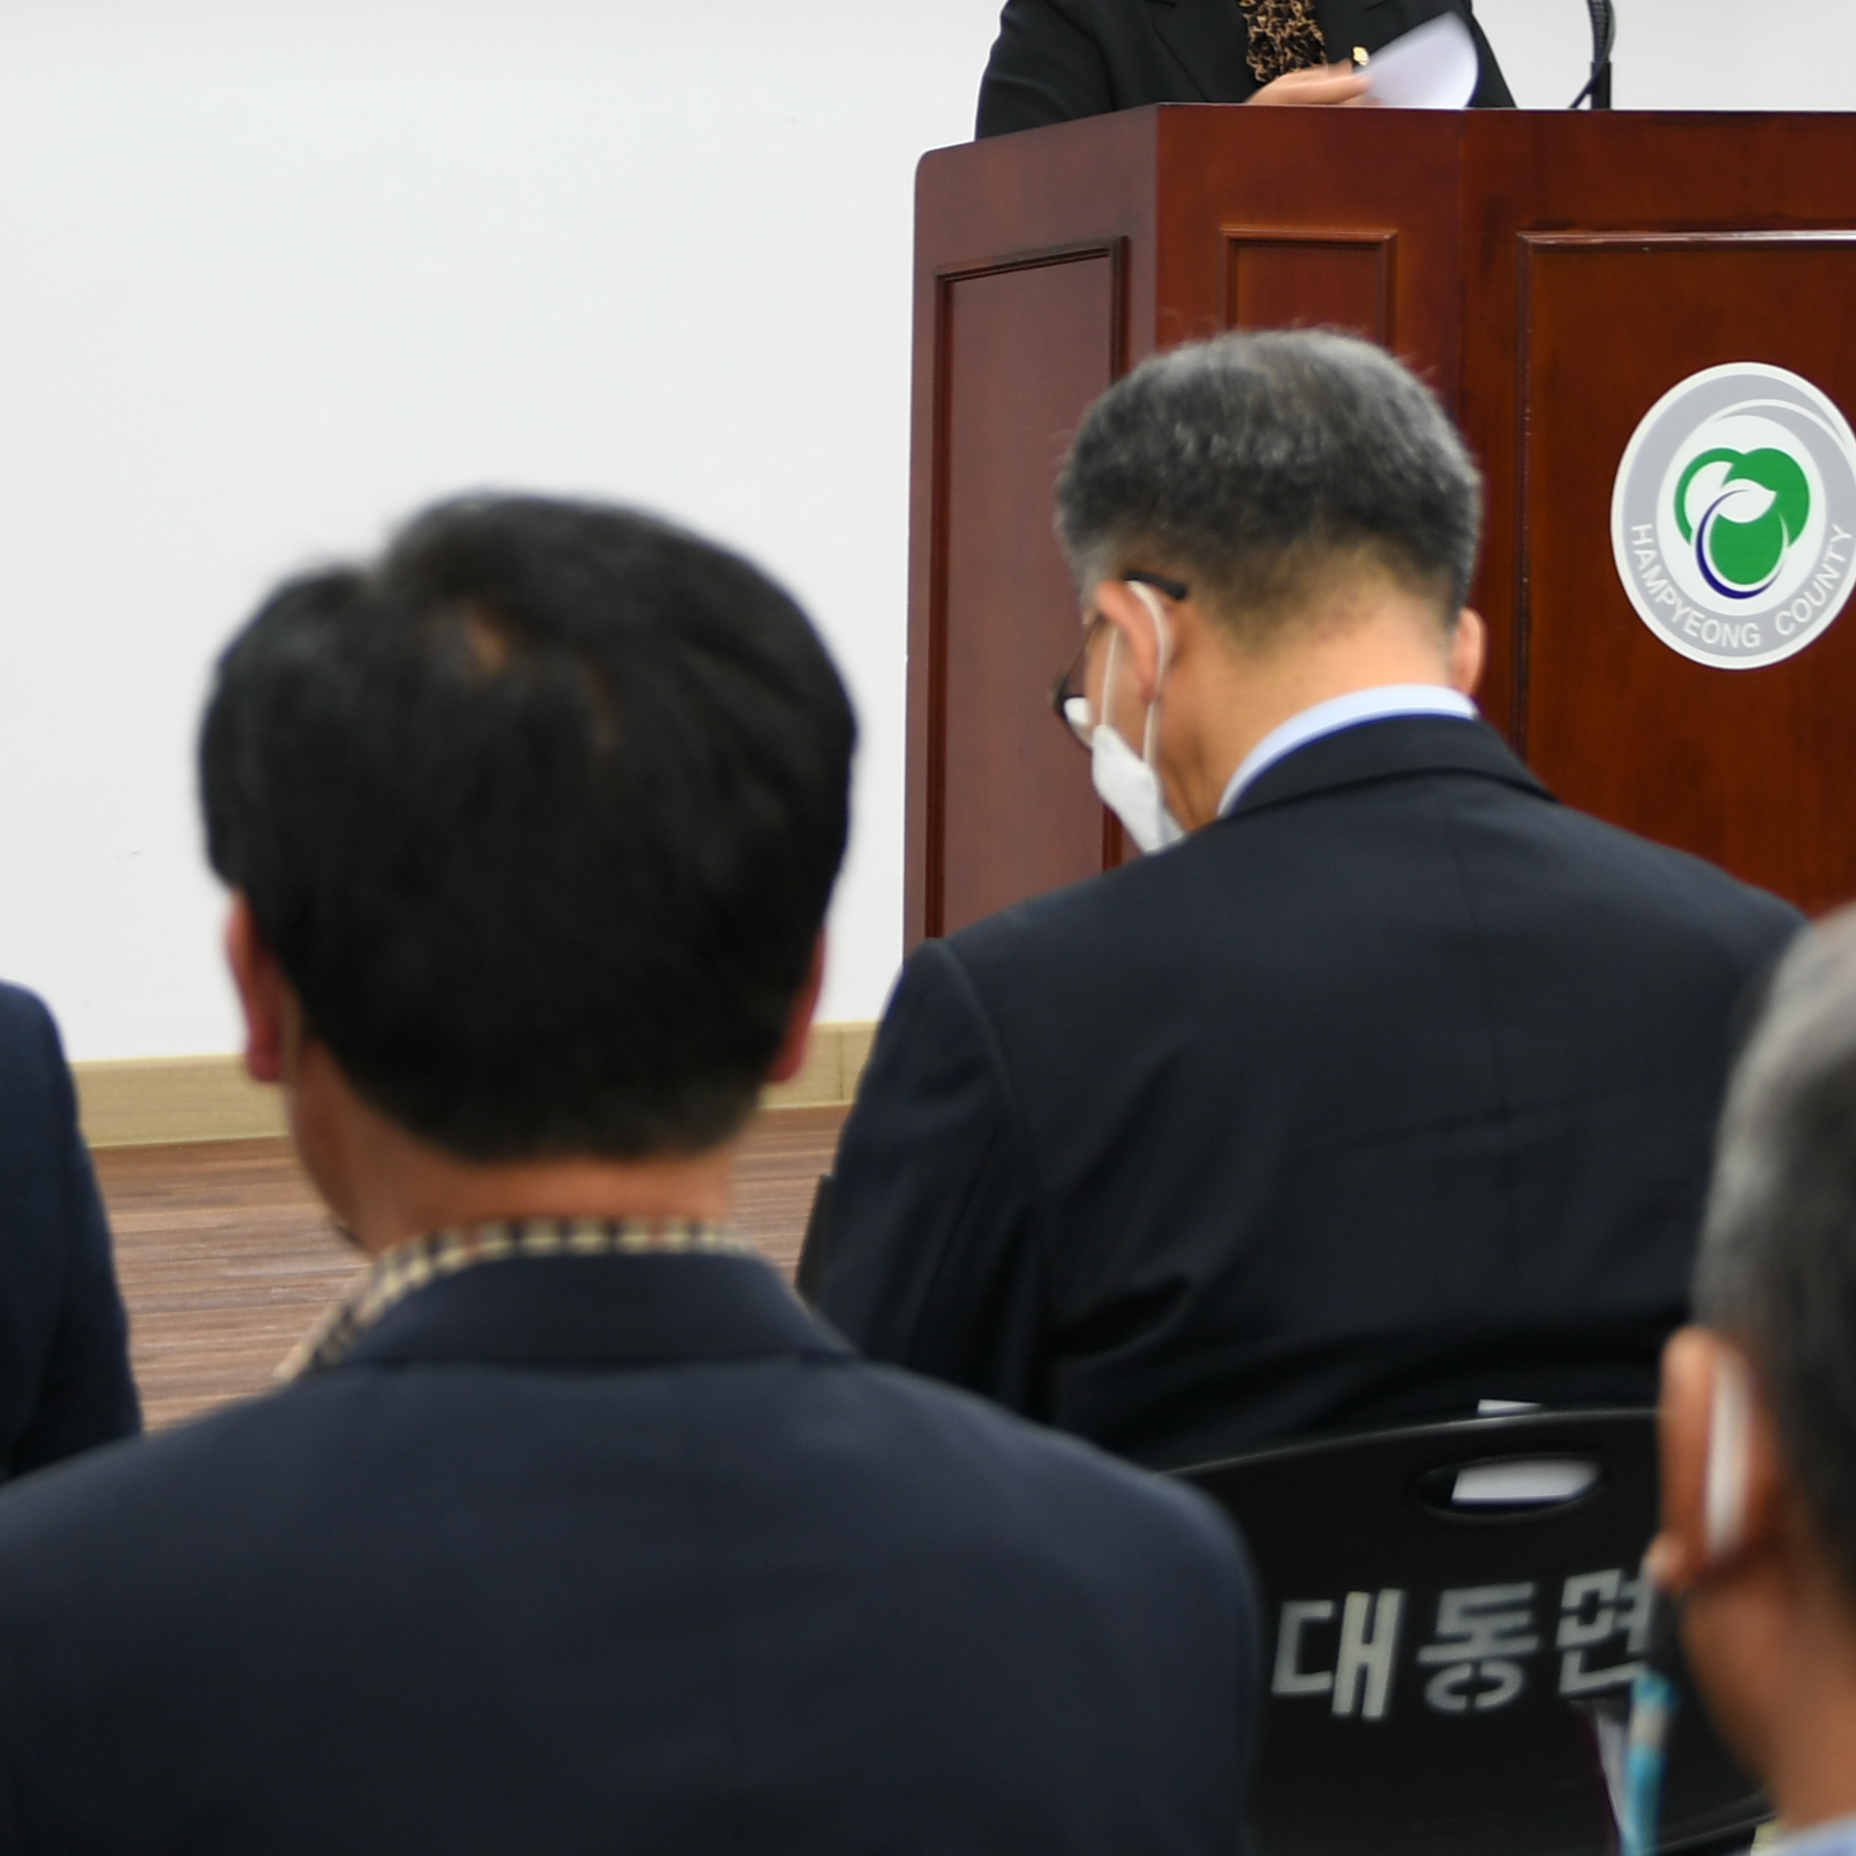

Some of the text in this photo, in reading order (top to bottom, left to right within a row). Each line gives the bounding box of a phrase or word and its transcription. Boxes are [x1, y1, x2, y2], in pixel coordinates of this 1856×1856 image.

[1630, 523, 1853, 649] HAMPYEONG COUNTY
[1270, 1568, 1654, 1721] 대동면
